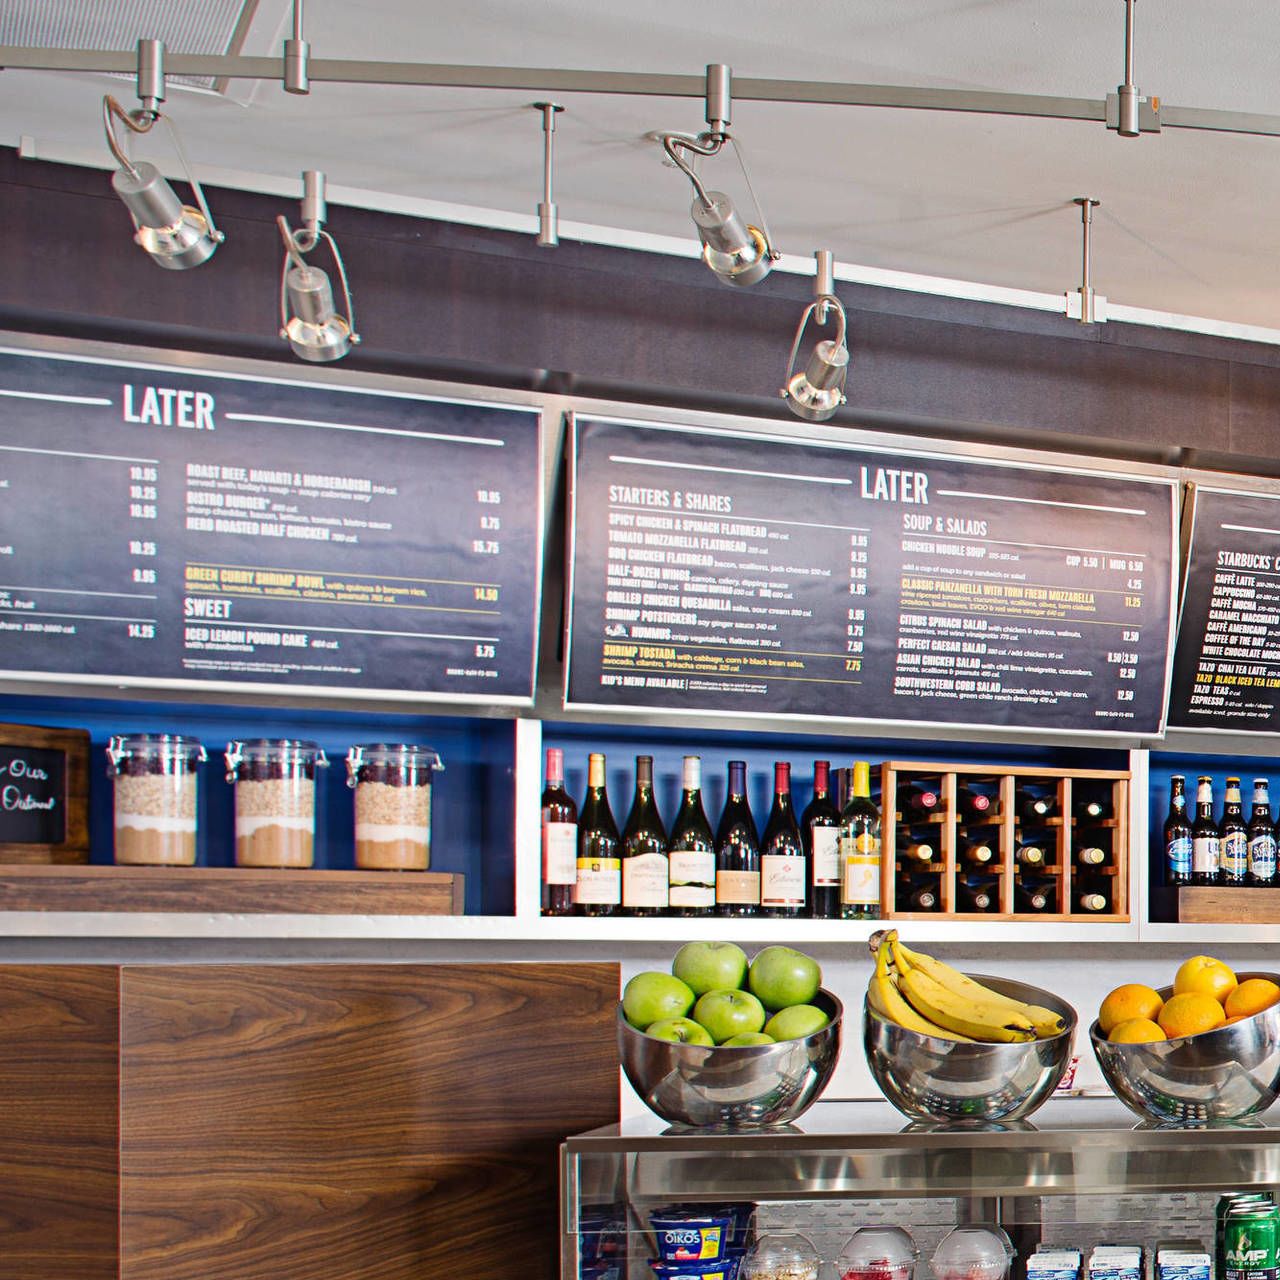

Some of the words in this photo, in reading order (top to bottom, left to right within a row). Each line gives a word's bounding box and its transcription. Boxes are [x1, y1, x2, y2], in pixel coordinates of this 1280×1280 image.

[123, 384, 215, 430] LATER
[186, 463, 220, 478] ROAST
[250, 469, 292, 485] HAVARTI
[303, 474, 371, 492] HORSERADISH
[860, 466, 929, 505] LATER
[186, 491, 224, 506] BISTRO
[608, 485, 670, 507] STARTERS
[673, 491, 682, 508] &
[685, 492, 732, 512] SHARES
[186, 517, 214, 531] HERB
[215, 519, 259, 534] ROASTED
[261, 523, 286, 536] HALF
[287, 525, 330, 540] CHICKEN
[608, 513, 635, 526] SPICY
[636, 515, 673, 530] CHICKEN
[683, 519, 719, 534] SPINACH
[720, 523, 767, 538] FLATBREAD
[903, 513, 932, 531] SOUP
[947, 517, 988, 537] SALADS
[608, 529, 643, 544] TOMATO
[644, 533, 699, 549] MOZZARELLA
[701, 538, 746, 553] FLATBREAD
[608, 547, 626, 561] BBQ
[628, 549, 666, 562] CHICKEN
[667, 552, 714, 567] FLATBREAD
[902, 540, 935, 554] CHICKEN
[936, 543, 964, 556] NOODLE
[966, 547, 986, 559] SOUP
[1066, 555, 1081, 567] CUP
[1110, 559, 1126, 570] MUG
[1217, 551, 1272, 570] STARBUCKS
[185, 567, 219, 581] GREEN
[220, 570, 254, 584] CURRY
[255, 572, 295, 585] SHRIMP
[296, 575, 325, 588] BOWL
[662, 568, 691, 581] WINGS
[1236, 576, 1255, 587] LATTE
[901, 578, 934, 590] CLASSIC
[935, 581, 983, 594] PANZANELLA
[983, 585, 1002, 595] WITH
[1024, 589, 1047, 600] FRESH
[1049, 591, 1095, 604] MOZZARELLA
[1213, 585, 1256, 599] CAPPUCCINO
[184, 598, 232, 618] SWEET
[606, 590, 641, 605] GRILLED
[643, 593, 680, 607] CHICKEN
[681, 596, 732, 611] QUESADILLA
[1232, 599, 1257, 611] MOCHA
[605, 608, 640, 621] SHRIMP
[641, 610, 697, 625] POTSTICKERS
[899, 614, 928, 627] CITRUS
[928, 616, 962, 629] SPINACH
[962, 619, 988, 631] SALAD
[1209, 610, 1240, 621] CARAMEL
[1241, 612, 1280, 625] MACCHIATO
[184, 628, 209, 641] ICED
[210, 629, 245, 643] LEMON
[246, 631, 281, 646] POUND
[282, 633, 308, 648] CAKE
[630, 626, 672, 640] HUMMUS
[1228, 624, 1267, 635] AMERICANO
[898, 638, 931, 650] PERFECT
[931, 641, 961, 652] CAESAR
[962, 643, 987, 654] SALAD
[1204, 633, 1229, 645] COFFEE
[603, 644, 638, 657] SHRIMP
[639, 646, 676, 660] TOSTADA
[846, 659, 861, 672] 7.75
[1202, 645, 1224, 656] WHITE
[1224, 647, 1261, 659] CHOCOLATE
[896, 653, 921, 665] ASIAN
[922, 656, 955, 667] CHICKEN
[956, 657, 981, 669] SALAD
[1218, 663, 1235, 674] CHAI
[1235, 665, 1247, 675] TEA
[1248, 666, 1267, 676] LATTE
[600, 674, 623, 686] KID'S
[623, 676, 645, 687] MENU
[646, 677, 685, 689] AVAILABLE
[894, 677, 954, 690] SOUTHWESTERN
[955, 680, 976, 691] COBB
[976, 681, 1001, 693] SALAD
[1215, 675, 1237, 685] BLACK
[1190, 695, 1224, 706] ESPRESSO
[1226, 1250, 1268, 1260] AMP
